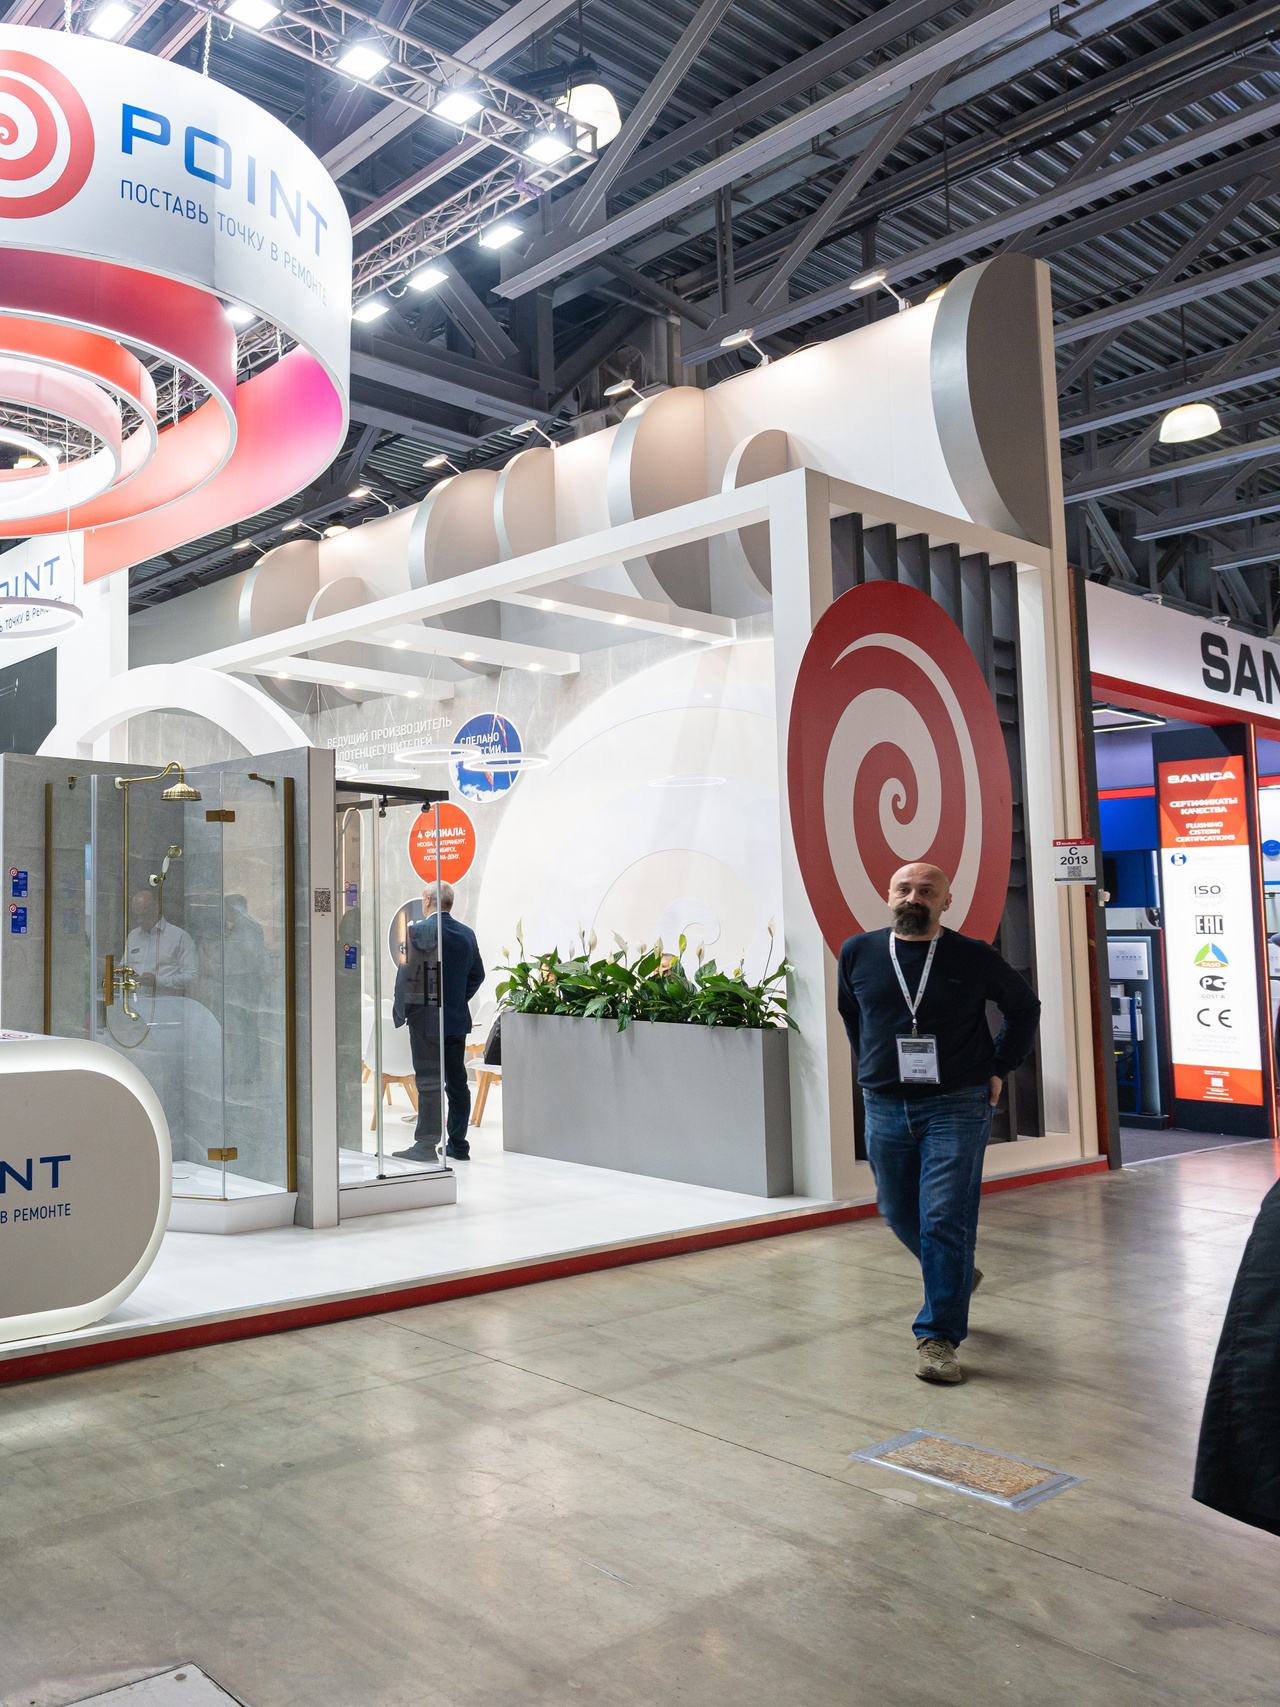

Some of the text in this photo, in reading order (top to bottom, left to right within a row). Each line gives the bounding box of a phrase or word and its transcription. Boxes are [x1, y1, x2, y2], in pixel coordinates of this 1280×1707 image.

[122, 103, 328, 257] POINT
[121, 179, 327, 306] ПОСТАВЬ ТОЧКУ В РЕМОНТЕ
[5, 612, 24, 630] ТОЧКУ
[26, 610, 31, 621] В
[327, 716, 452, 749] ВЕДУЩИЙ ПРОИЗВОДИТЕЛЬ
[336, 733, 433, 762] ЛОТЕНЦЕСУШИТЕЛЕЙ
[1167, 771, 1236, 784] SANICA
[1169, 797, 1238, 808] СЕРТИФИКАТЫ
[1181, 806, 1228, 815] КАЧЕСТВА
[418, 831, 423, 839] 4
[1175, 834, 1236, 843] CERTIFICATIONS
[1069, 847, 1078, 856] C
[1060, 856, 1088, 865] 2013
[1194, 886, 1221, 895] ISO
[1197, 1008, 1232, 1028] CE
[0, 1210, 8, 1224] В
[14, 1203, 71, 1222] РЕМОНТЕ
